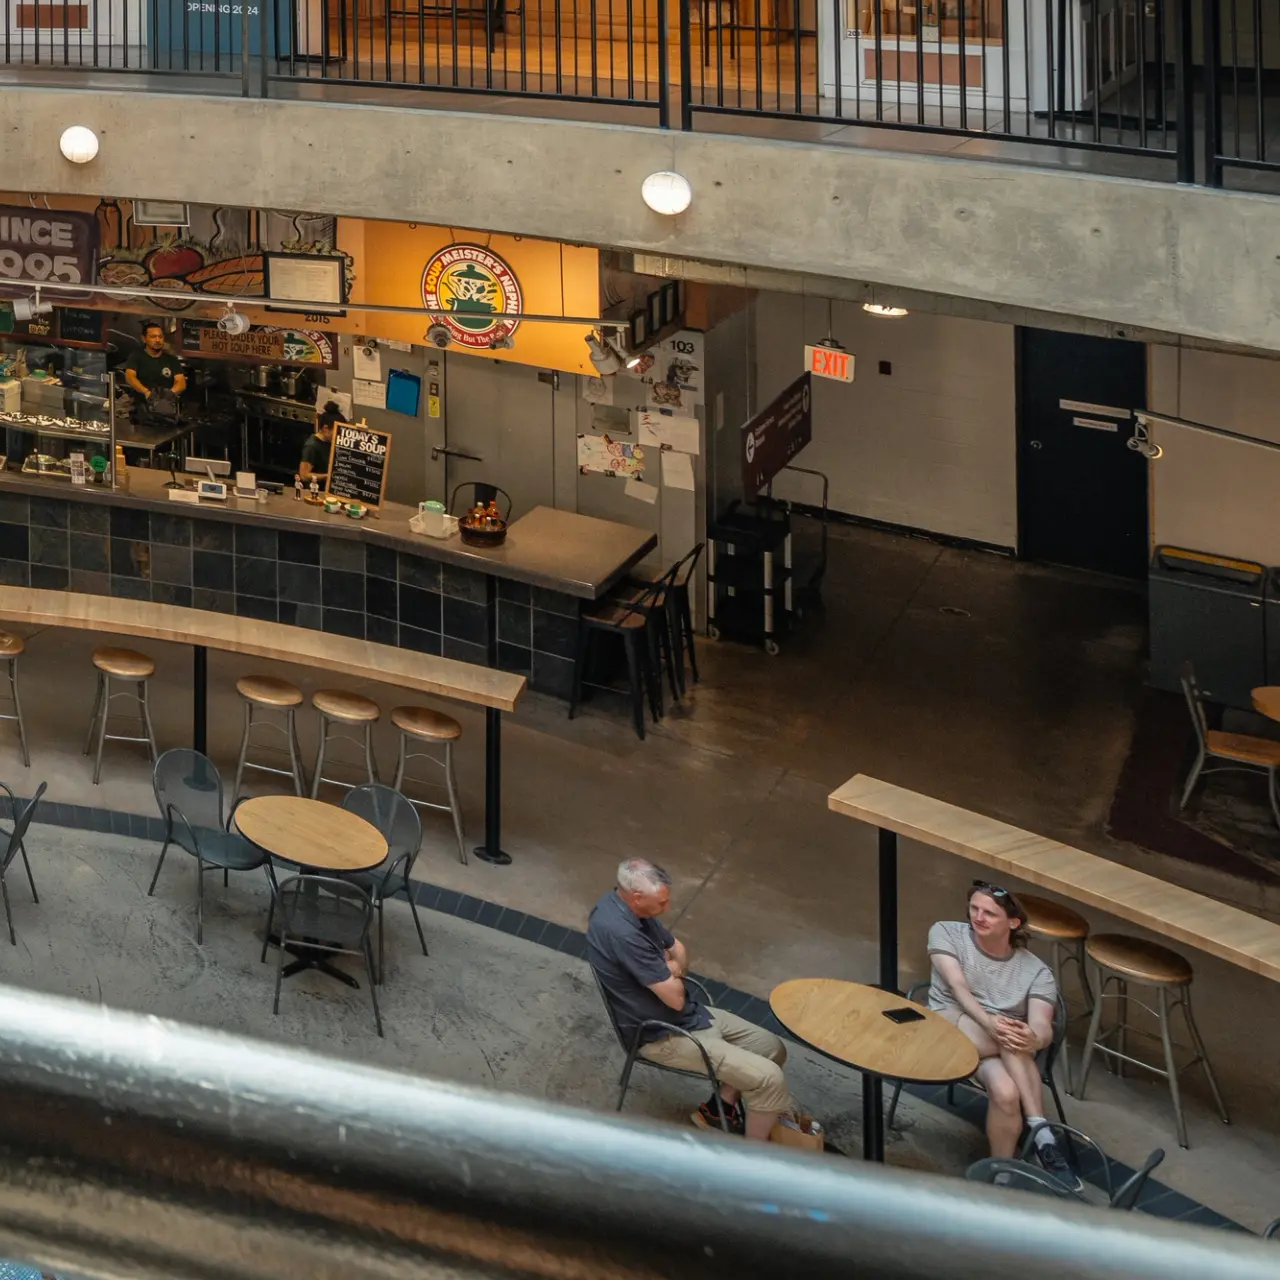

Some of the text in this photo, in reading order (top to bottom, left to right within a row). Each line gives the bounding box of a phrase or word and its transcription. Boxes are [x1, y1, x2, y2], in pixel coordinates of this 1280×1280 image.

[425, 261, 444, 293] SOUP
[439, 249, 505, 275] MEISTER'S
[304, 313, 331, 325] 2015
[28, 324, 51, 336] DAY
[203, 328, 228, 341] PLEASE
[230, 332, 256, 345] ORDER
[257, 333, 281, 346] YOUR
[477, 336, 490, 344] The
[670, 340, 695, 354] 103
[211, 341, 272, 356] HOT SOUP HERE
[812, 349, 849, 380] EXIT
[340, 427, 379, 445] TODAY'S
[336, 435, 387, 455] HOT SOUP
